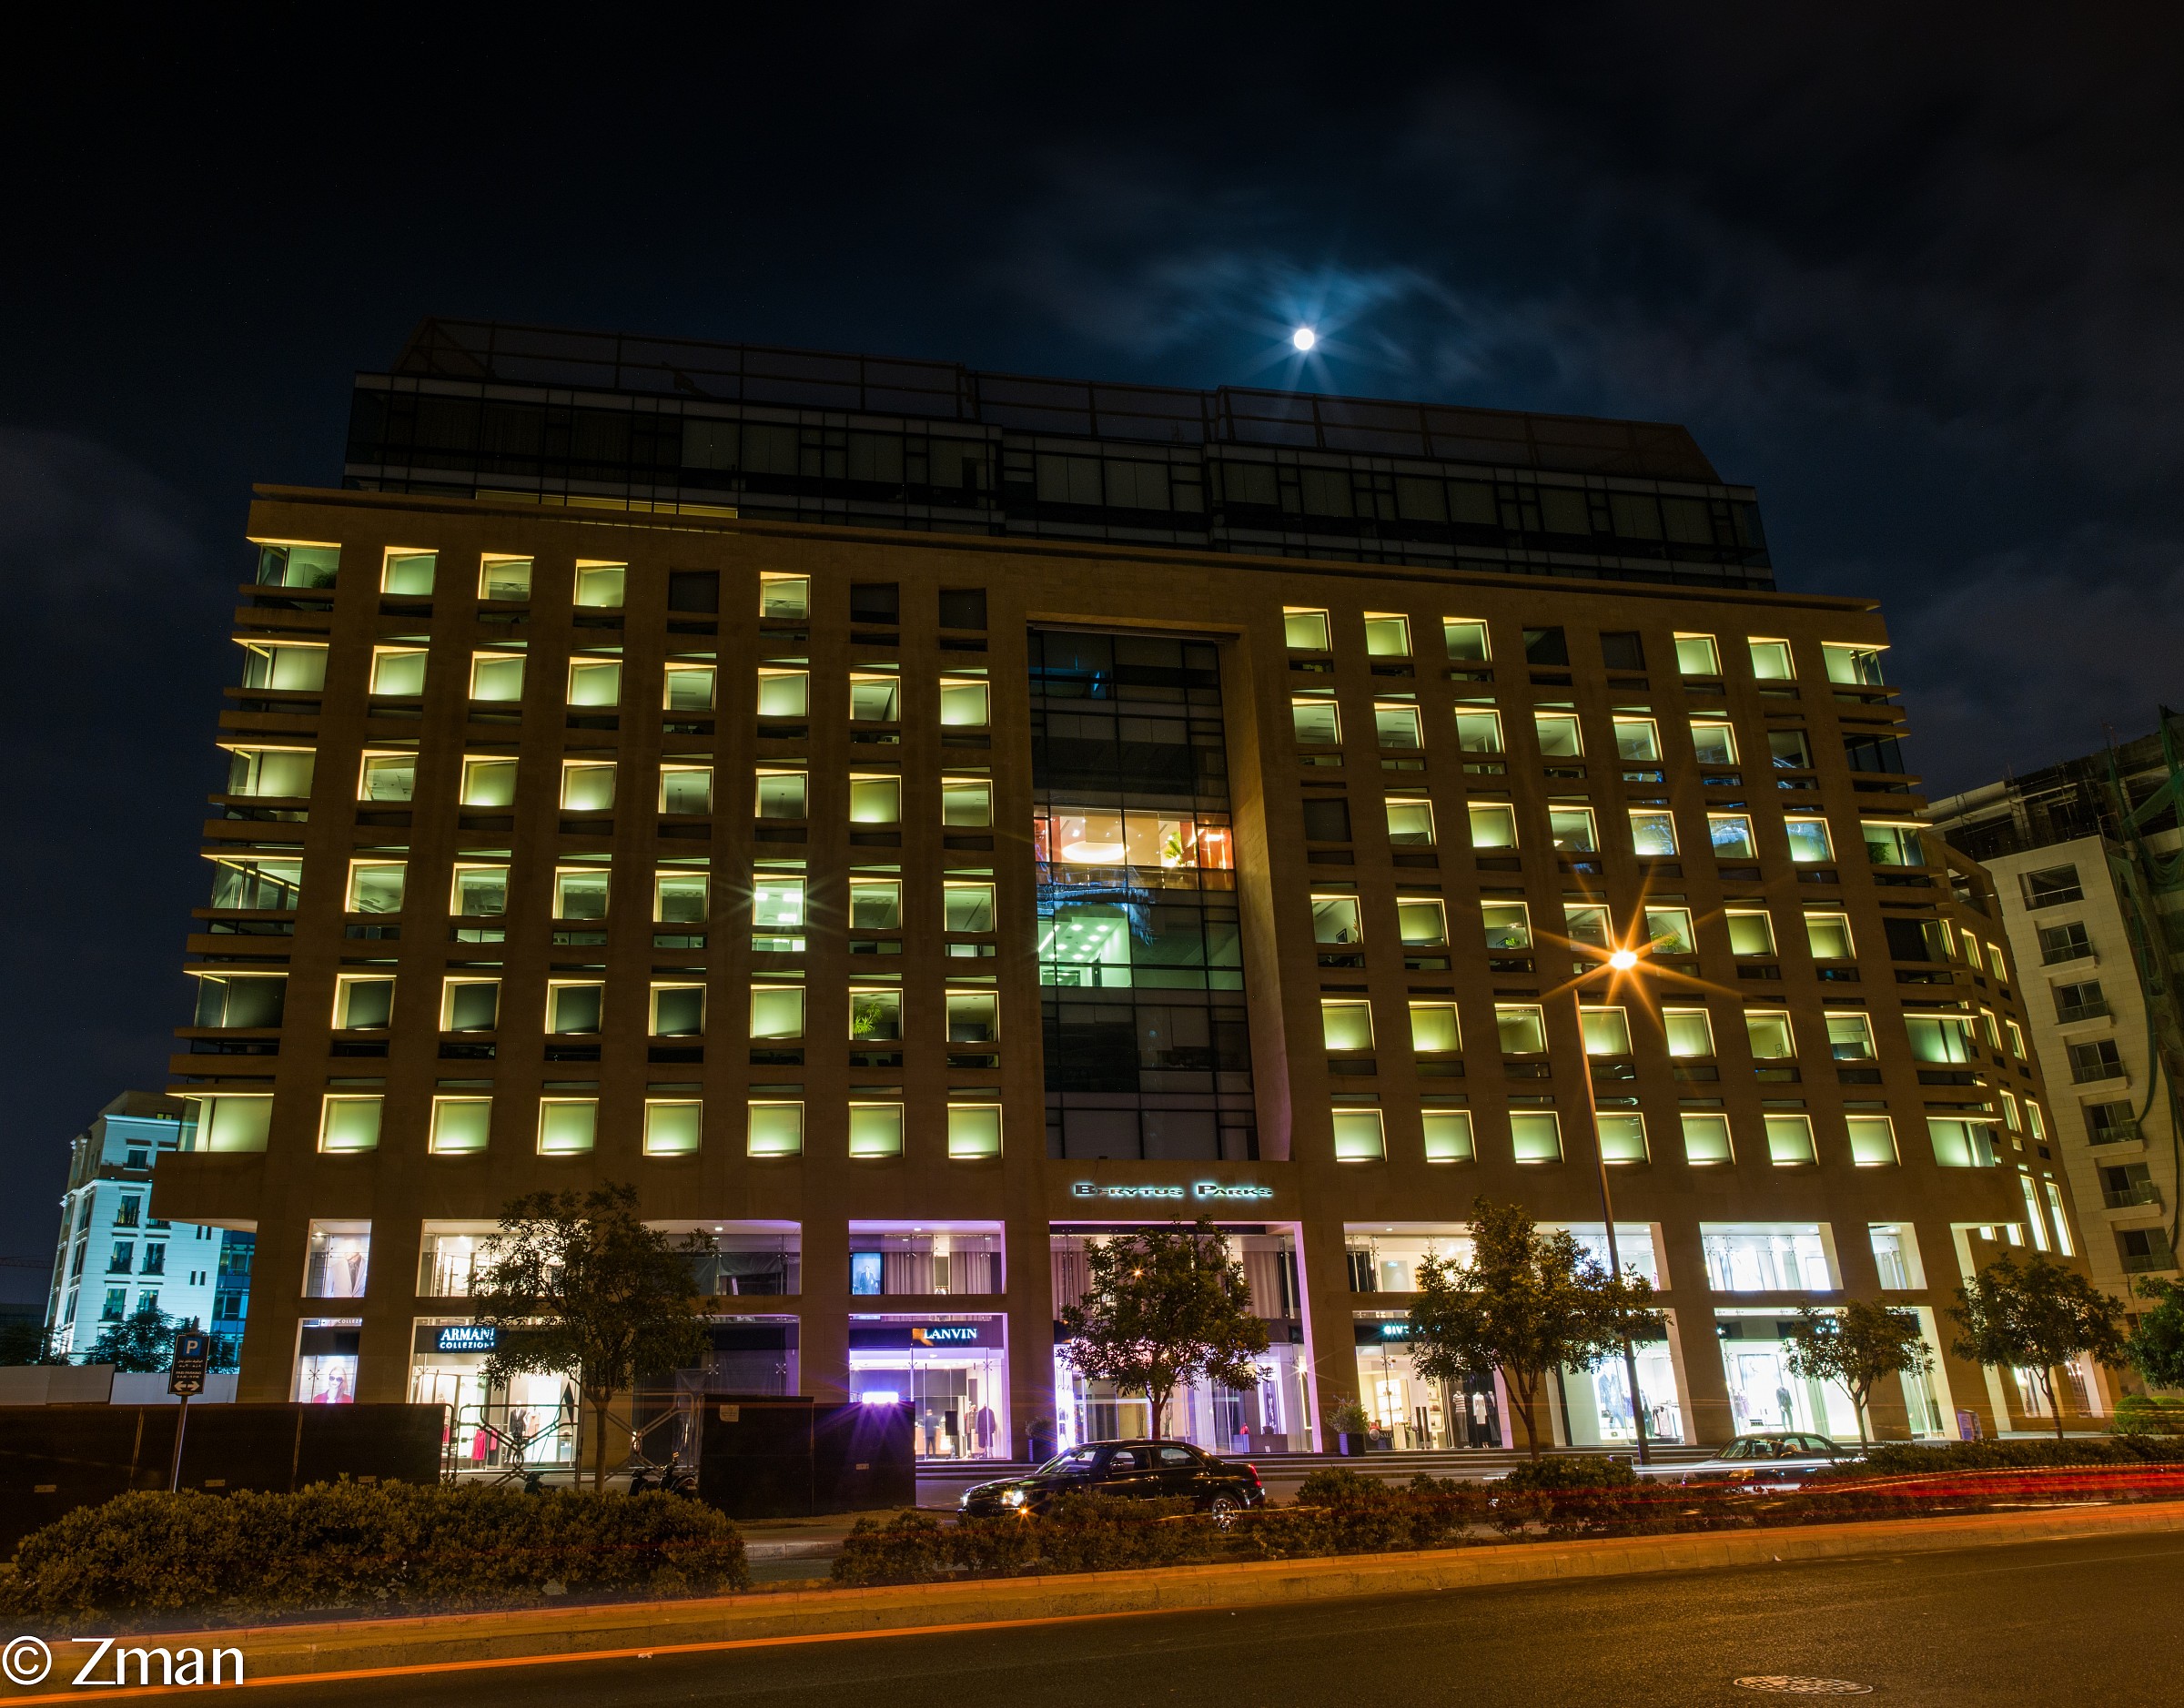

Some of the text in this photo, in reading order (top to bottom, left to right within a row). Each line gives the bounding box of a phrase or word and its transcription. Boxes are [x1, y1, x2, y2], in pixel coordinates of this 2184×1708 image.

[1075, 1184, 1272, 1195] BERYTUS PARKS
[924, 1329, 977, 1339] LANVIN
[186, 1340, 198, 1354] P
